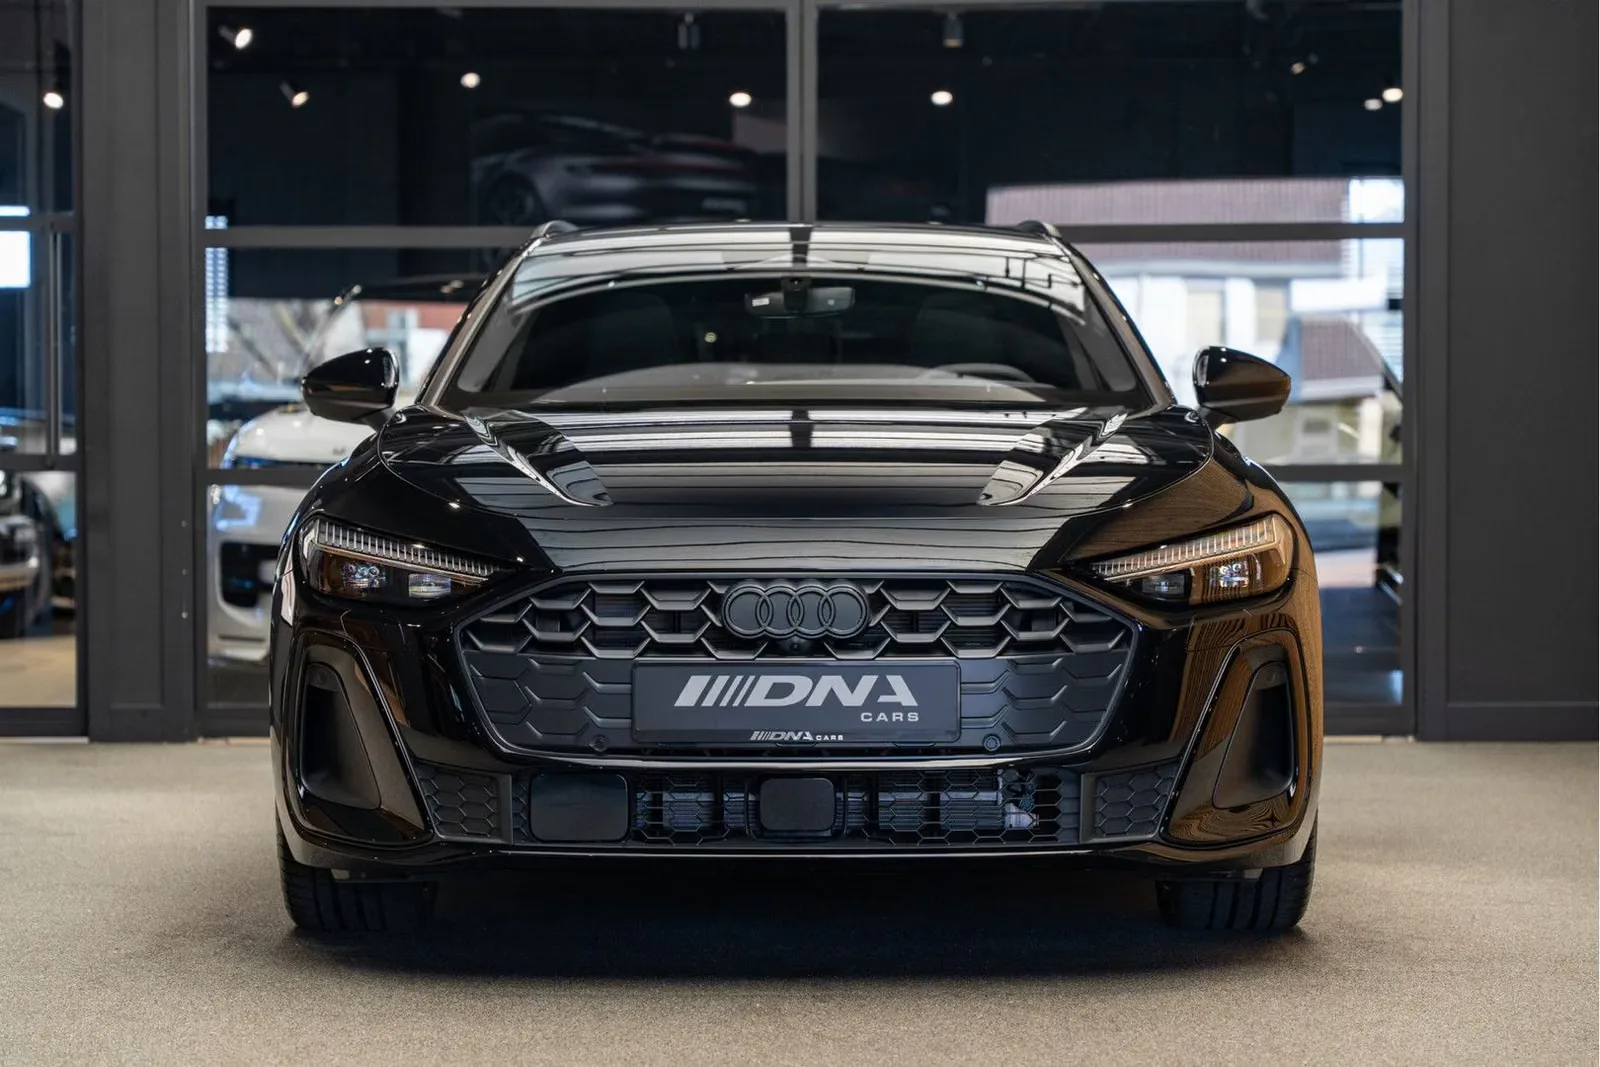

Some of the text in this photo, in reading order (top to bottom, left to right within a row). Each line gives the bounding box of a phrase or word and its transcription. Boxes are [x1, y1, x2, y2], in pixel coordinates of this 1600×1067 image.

[744, 675, 919, 707] DNA
[860, 712, 919, 722] CARS
[769, 731, 814, 741] DNA
